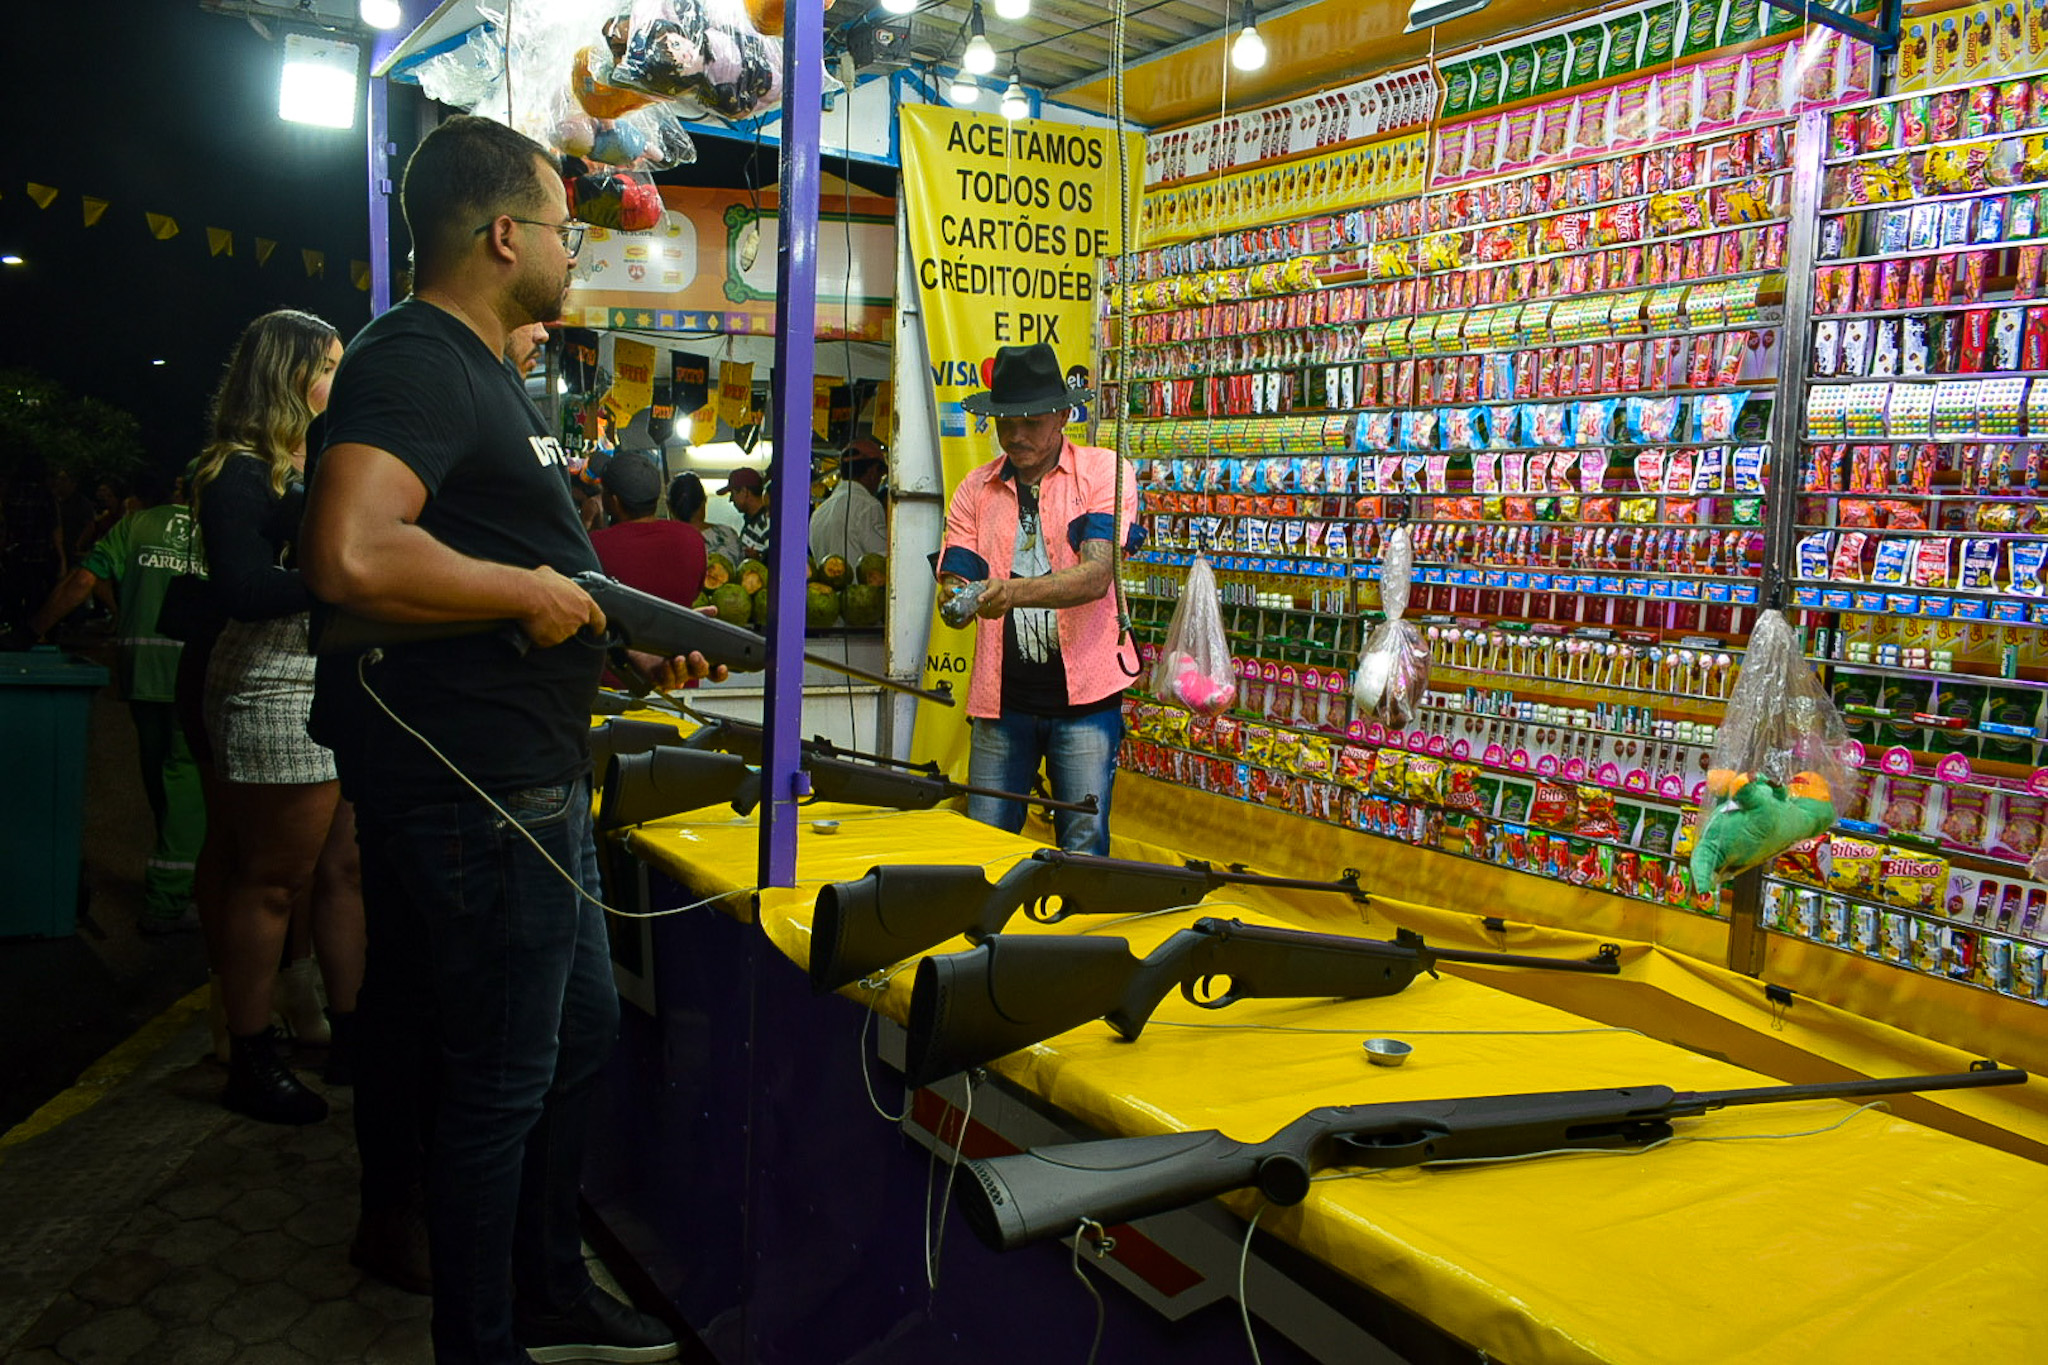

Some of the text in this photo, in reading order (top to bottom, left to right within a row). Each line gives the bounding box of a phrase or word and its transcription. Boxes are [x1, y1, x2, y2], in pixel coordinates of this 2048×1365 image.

[947, 121, 1102, 169] ACEITAMOS
[956, 168, 1093, 213] TODOS OS
[940, 214, 1109, 258] CARTÕES DE
[994, 311, 1060, 344] E PIX
[932, 360, 980, 388] VISA
[926, 652, 967, 673] NÃO
[1830, 842, 1878, 859] Bilisco
[1885, 857, 1942, 878] Bilisco
